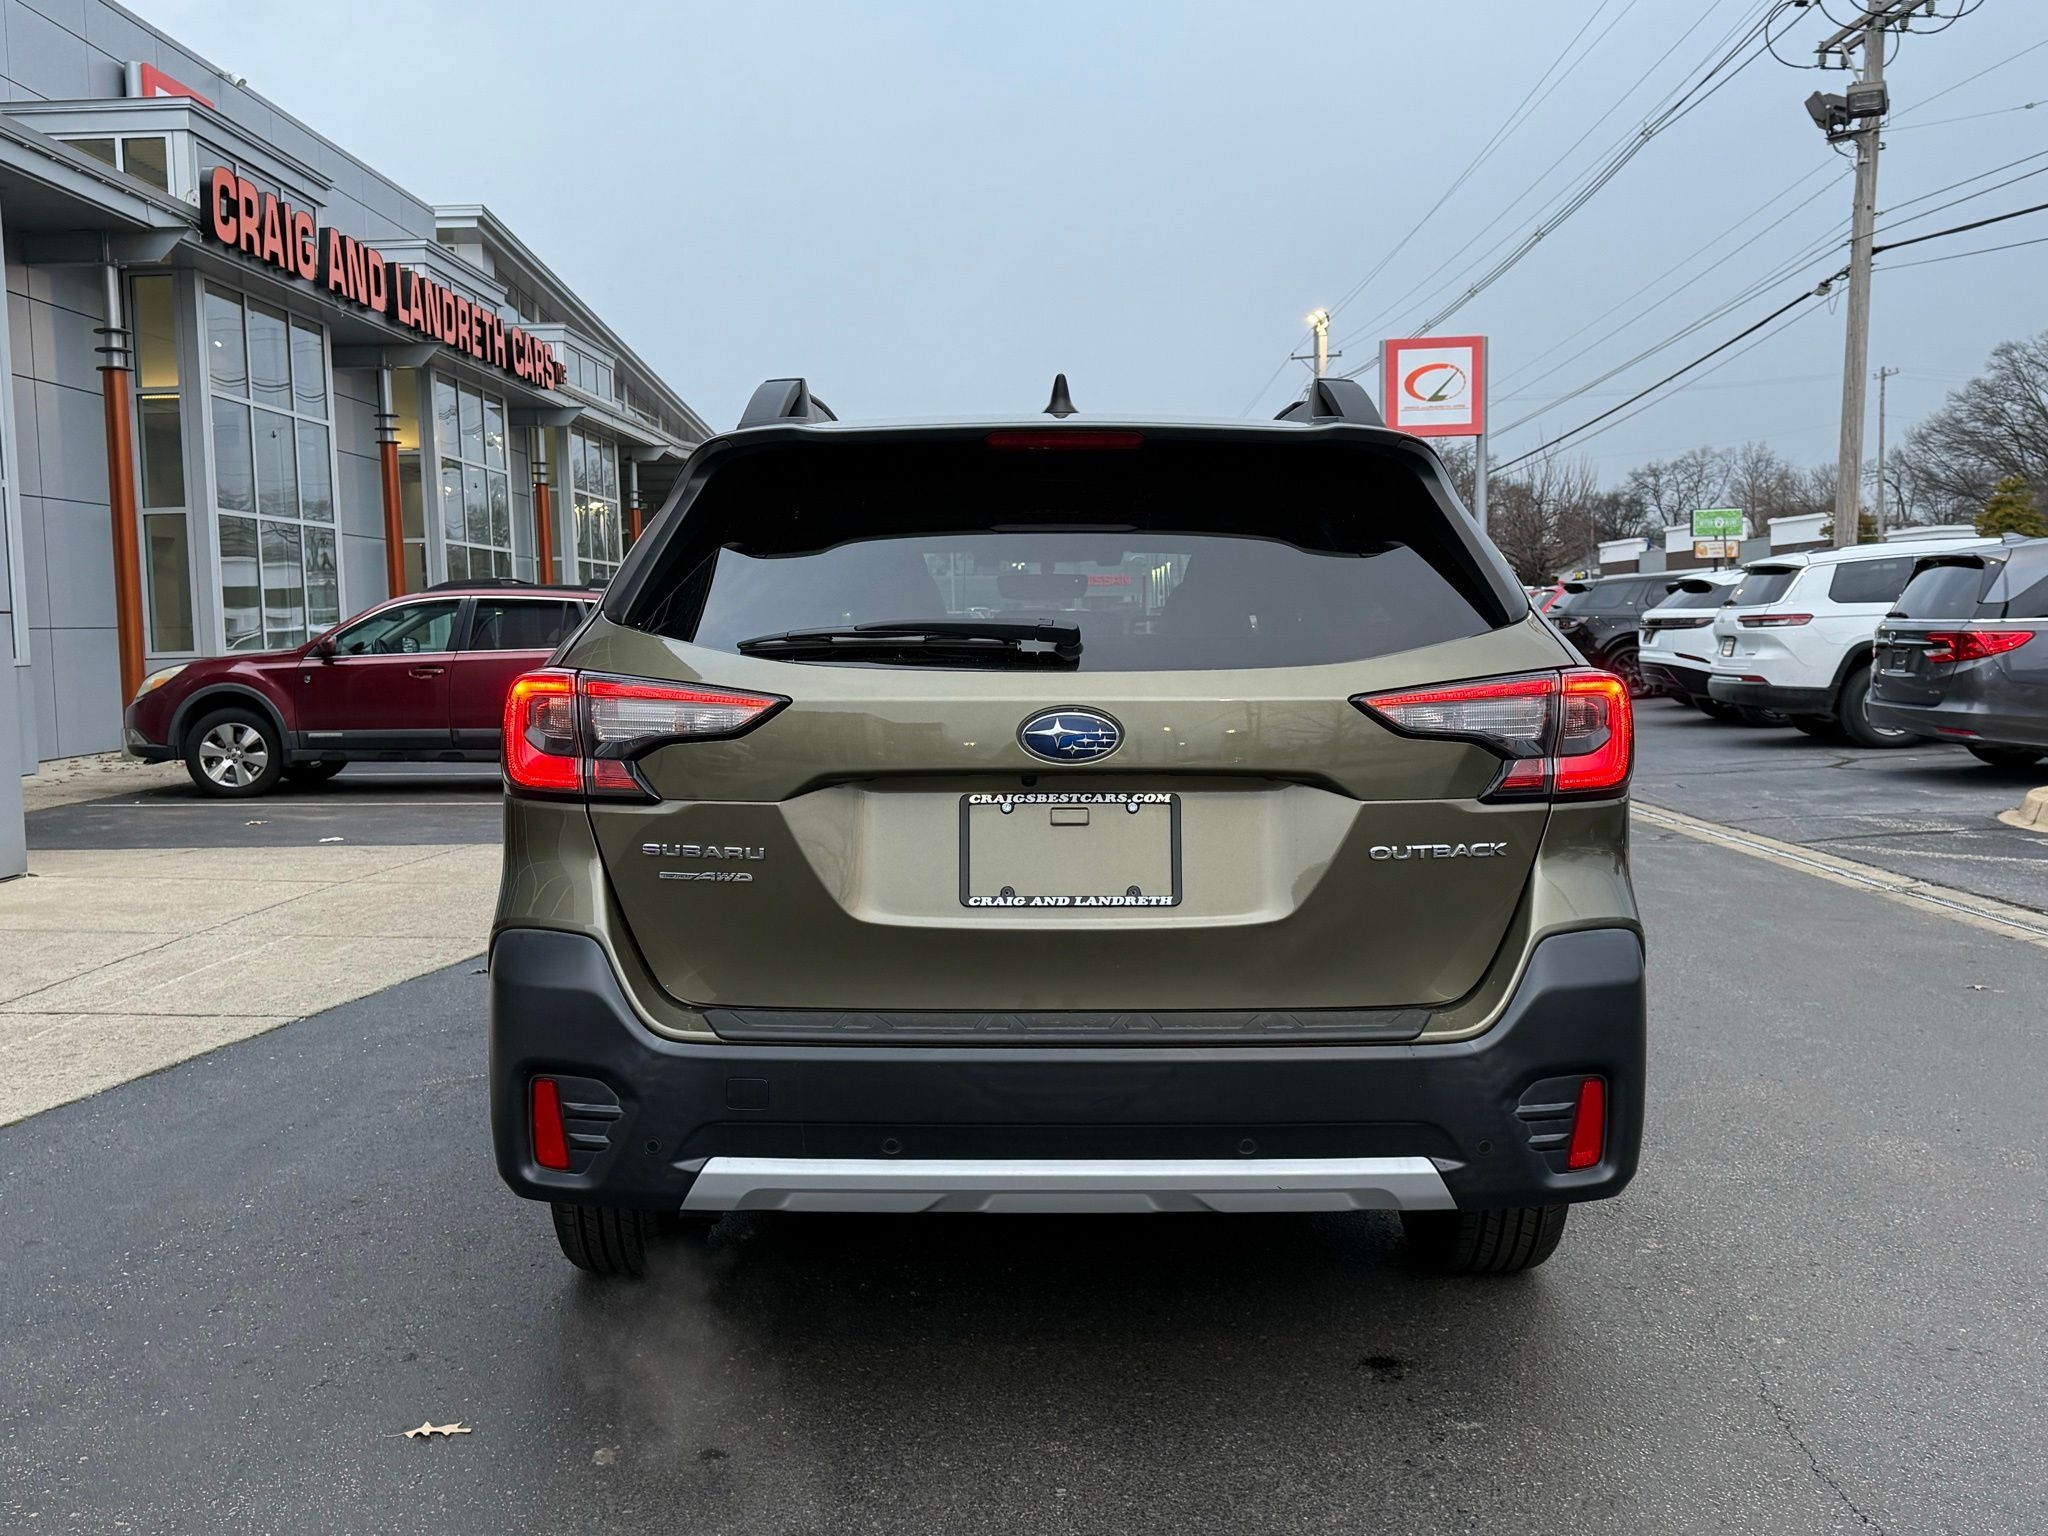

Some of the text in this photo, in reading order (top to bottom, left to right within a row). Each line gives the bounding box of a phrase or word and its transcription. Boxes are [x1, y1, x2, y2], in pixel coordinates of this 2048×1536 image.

[209, 165, 317, 282] CRAIG
[325, 226, 387, 313] AND
[393, 261, 508, 370] LANDRETH
[511, 326, 556, 391] CARS
[968, 793, 1172, 804] CRAIGSBESTCARS.COM
[641, 843, 766, 861] SUBARU
[1369, 842, 1508, 860] OUTBACK
[694, 871, 753, 882] AWD
[968, 896, 1173, 907] CRAIG AND LANDRETH
